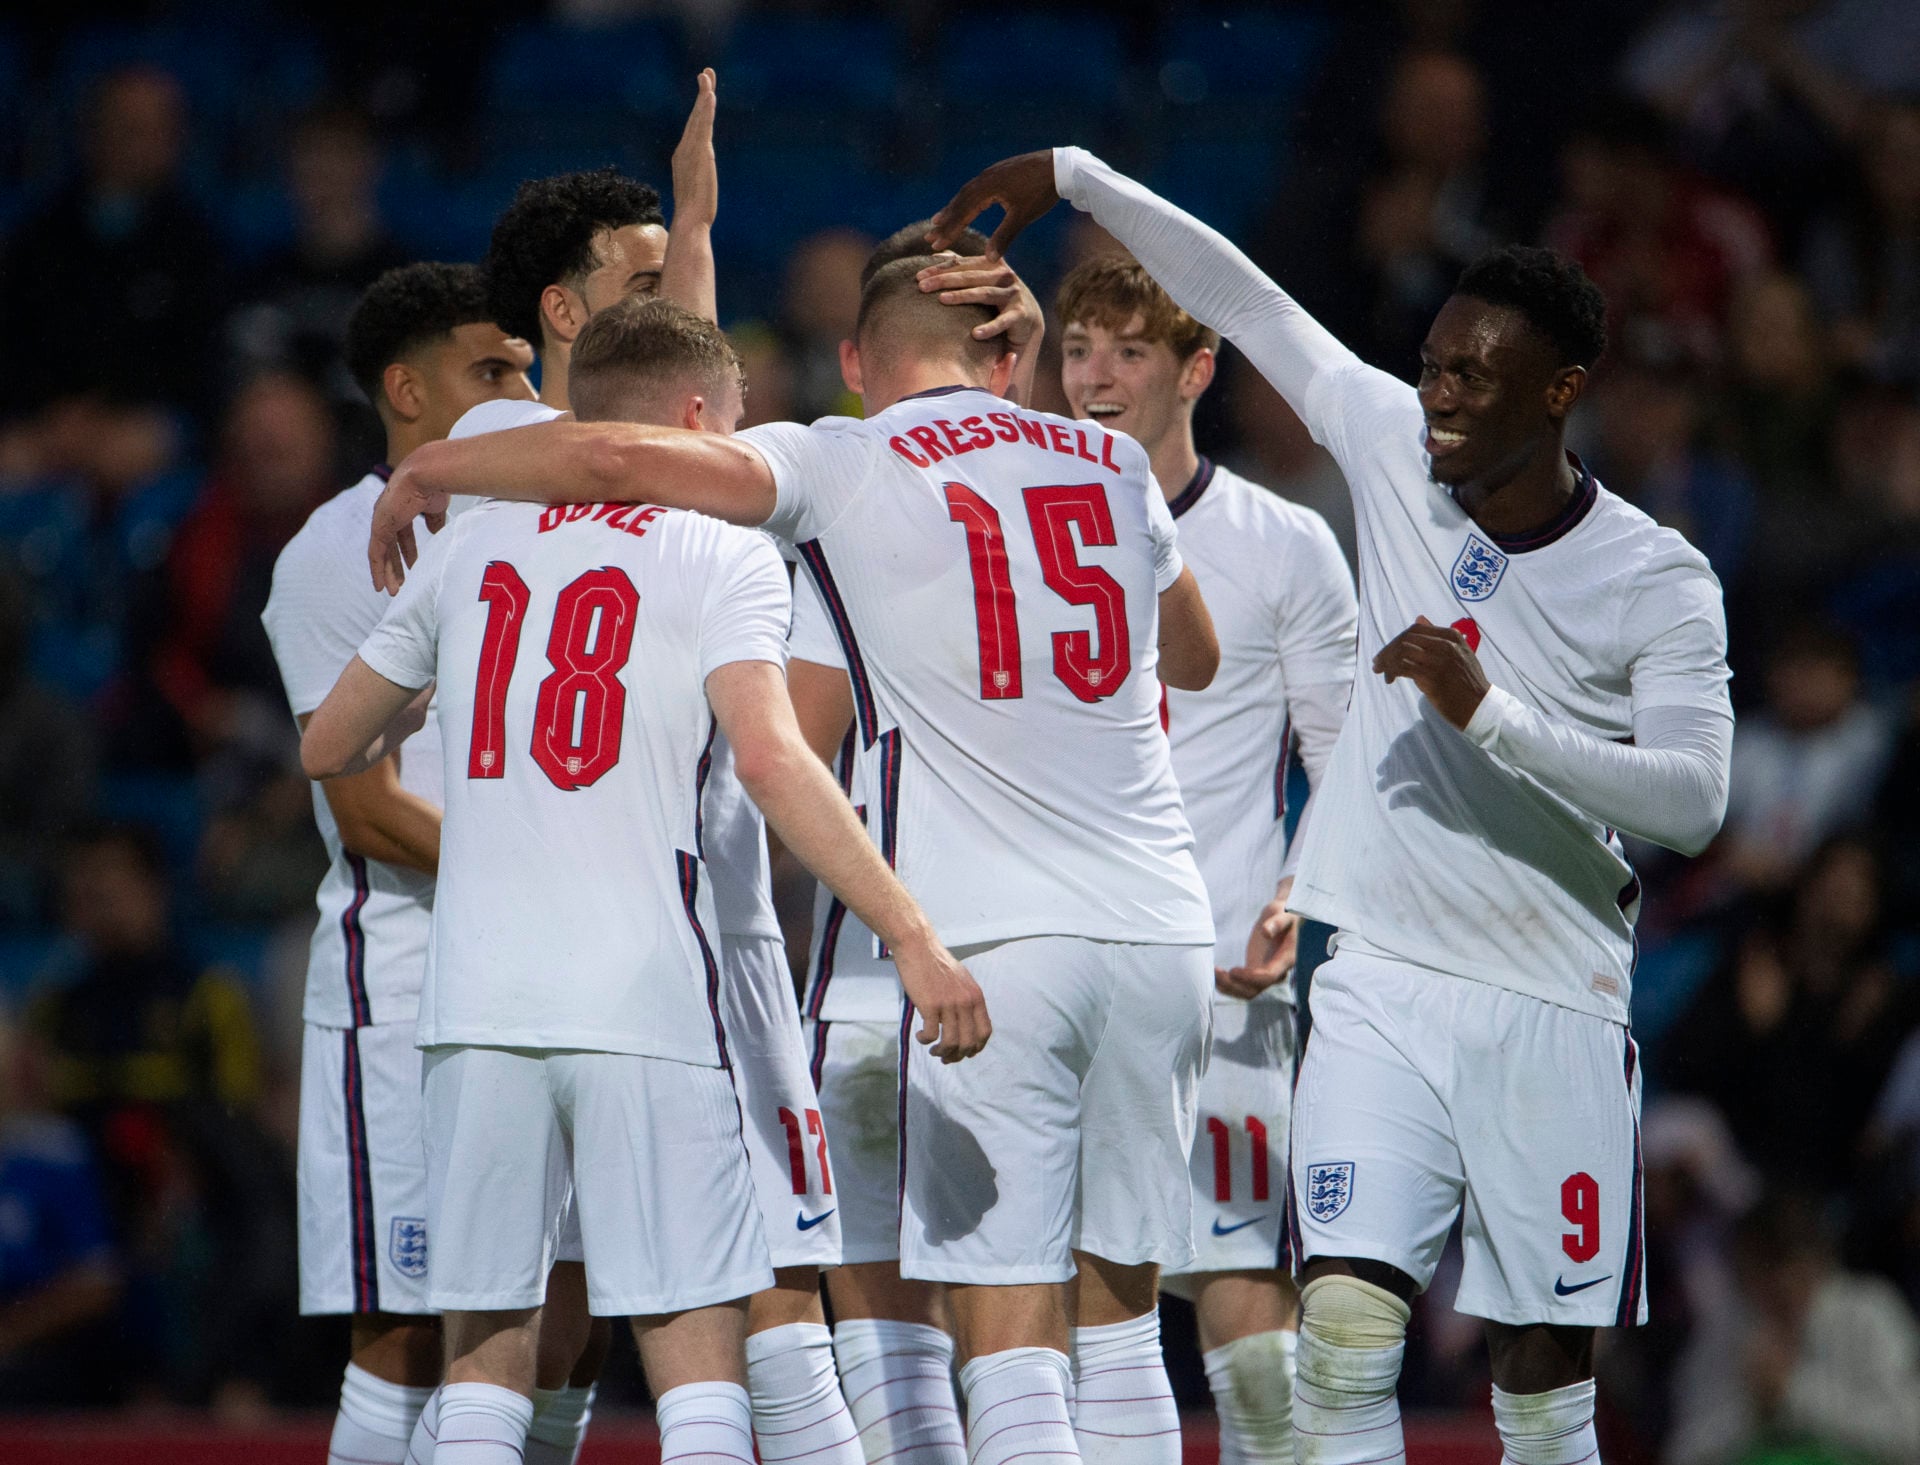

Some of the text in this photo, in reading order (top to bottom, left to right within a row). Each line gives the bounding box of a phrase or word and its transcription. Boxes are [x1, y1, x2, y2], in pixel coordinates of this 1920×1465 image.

[889, 412, 1121, 474] CRESSWELL
[943, 481, 1131, 703] 15
[468, 561, 640, 791] 18
[778, 1106, 832, 1194] 17
[1207, 1116, 1269, 1202] 11
[1561, 1172, 1600, 1263] 9
